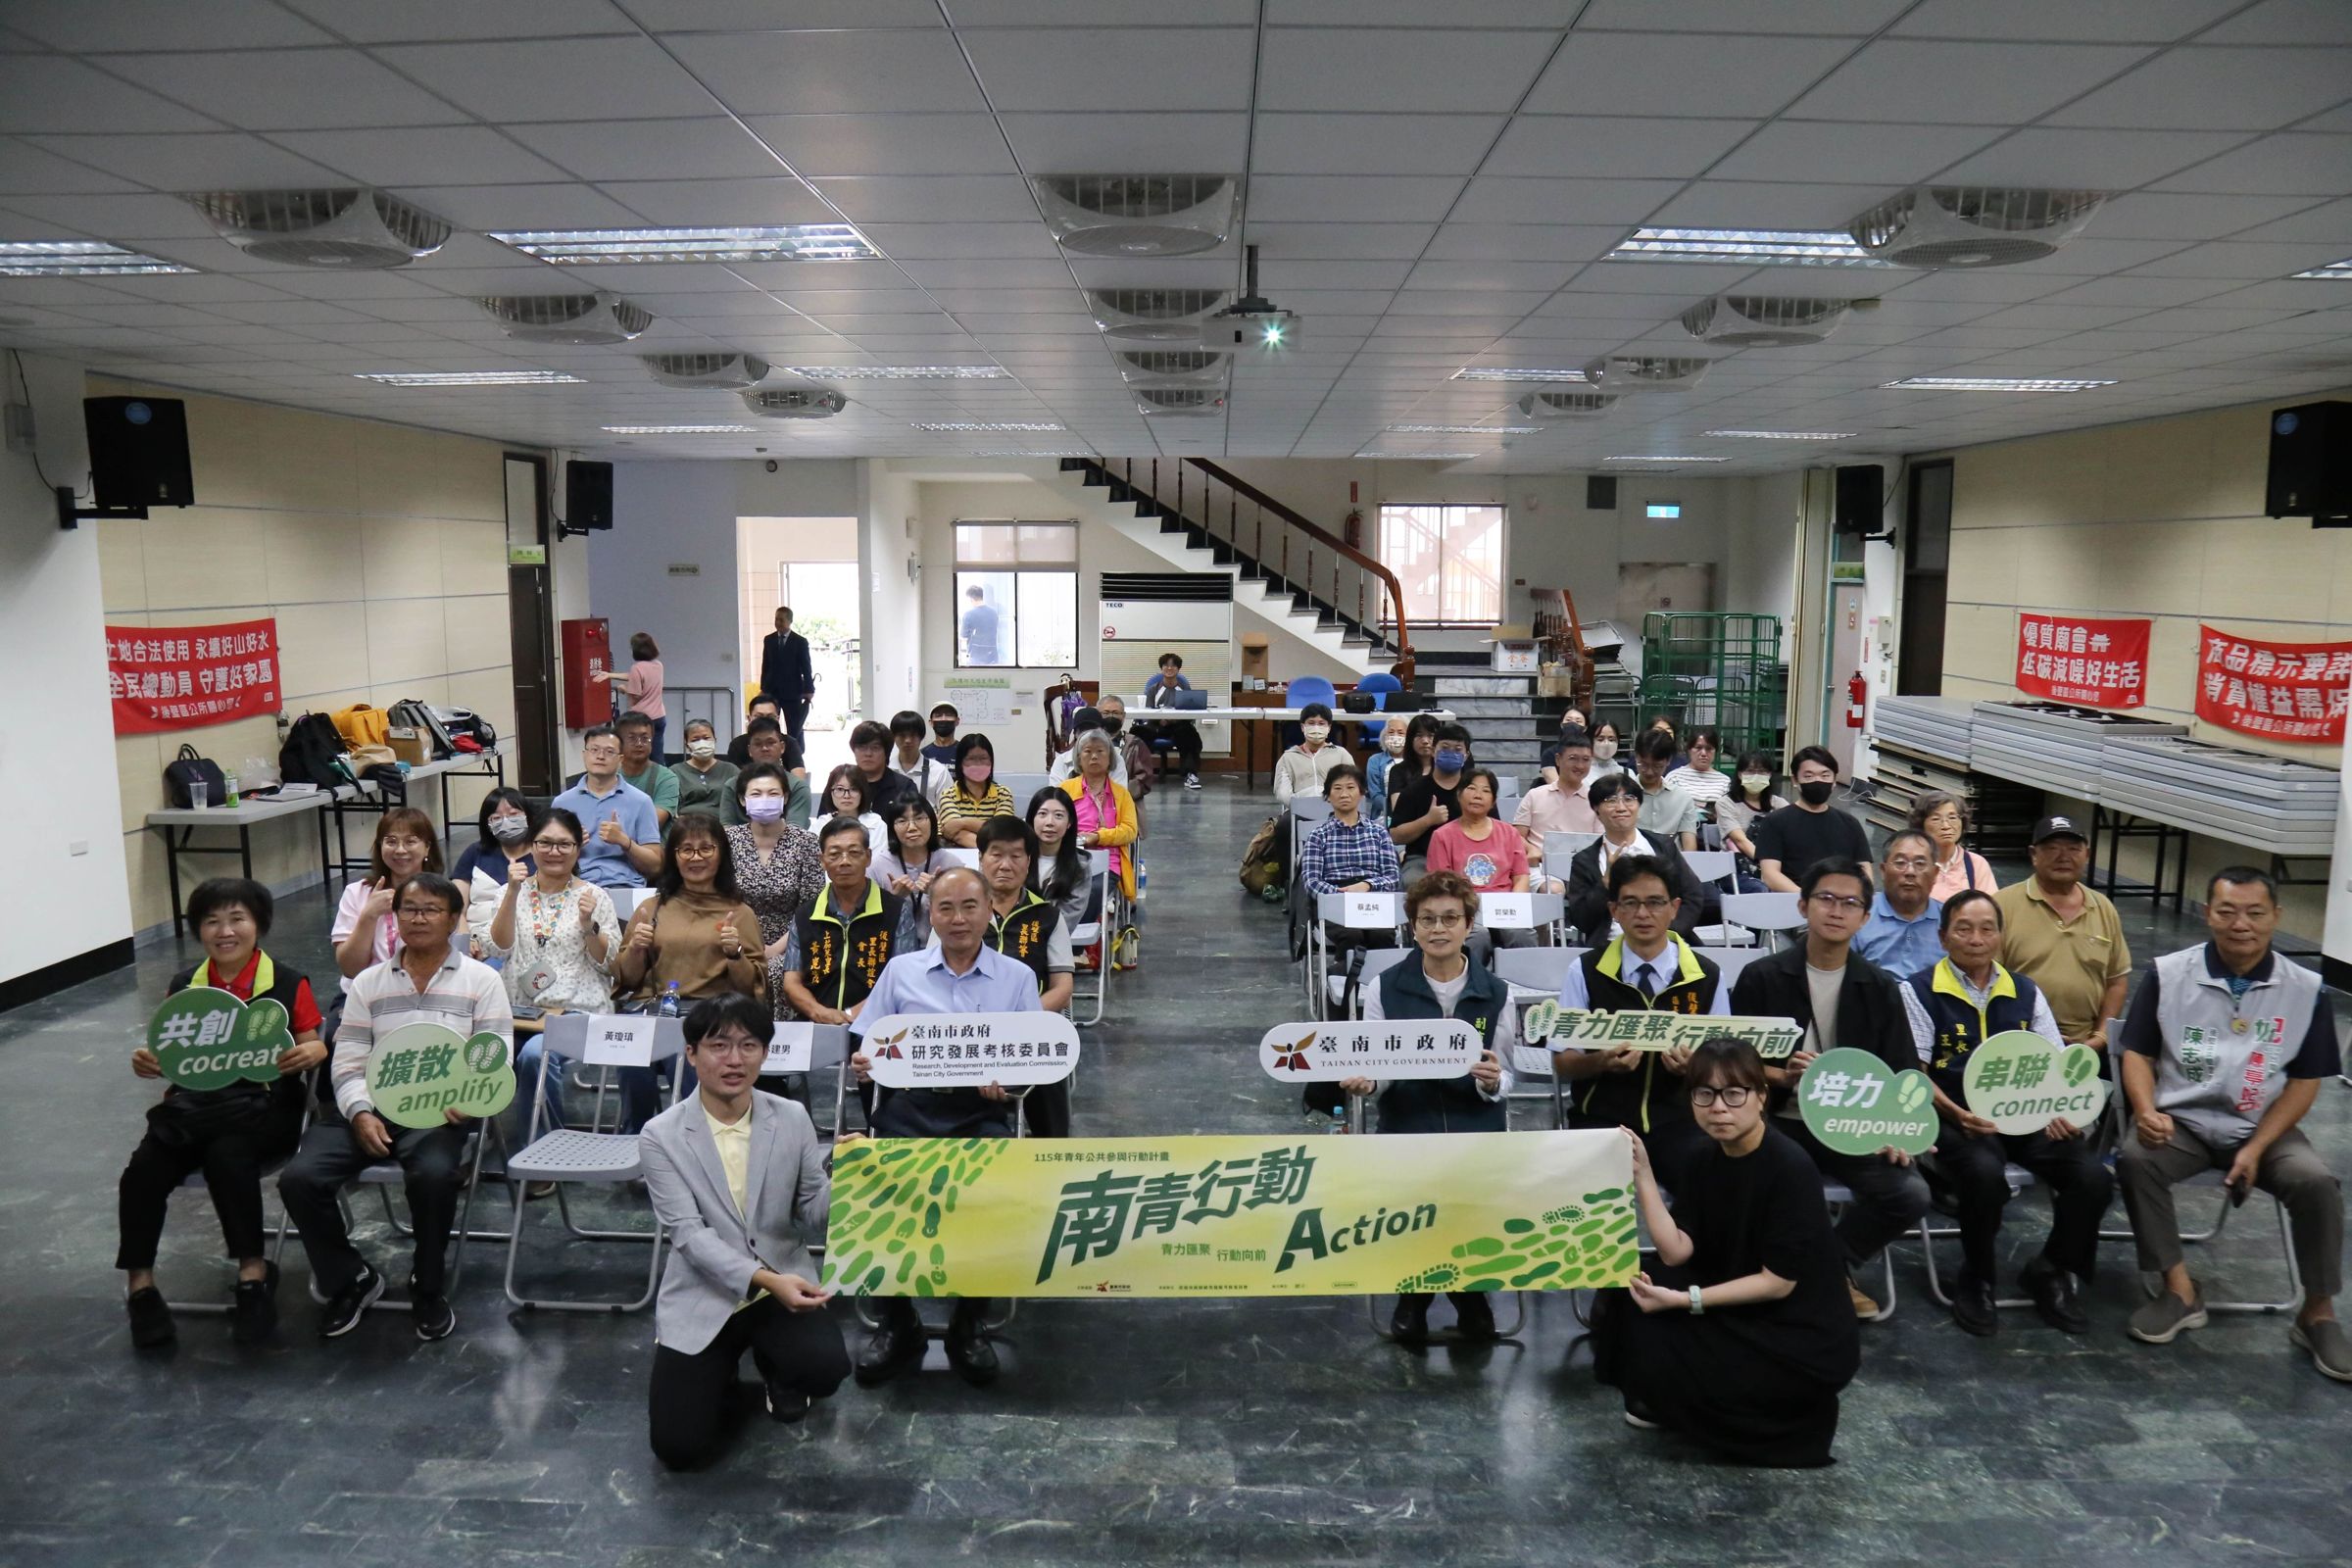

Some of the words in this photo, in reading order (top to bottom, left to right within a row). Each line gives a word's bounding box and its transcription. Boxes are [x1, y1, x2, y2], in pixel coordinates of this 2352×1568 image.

[196, 630, 270, 660] 永續好山好水
[2023, 621, 2088, 654] 優質廟會
[109, 670, 193, 699] 全民總動員
[199, 659, 273, 694] 守護好家園
[2021, 650, 2141, 689] 低碳減噪好生活
[156, 1007, 239, 1051] 共創
[911, 1024, 992, 1039] 臺南市政府
[1551, 1012, 1676, 1041] 青力匯聚
[177, 1044, 283, 1075] cocreat
[768, 1044, 791, 1055] 建男
[911, 1042, 1069, 1059] 研究發展考核委員會
[1319, 1034, 1468, 1054] 臺南市政府
[375, 1043, 458, 1090] 擴散
[1975, 1053, 2052, 1092] 串聯
[397, 1077, 503, 1113] amplify
[1807, 1071, 1886, 1108] 培力
[1991, 1091, 2094, 1117] connect
[1824, 1117, 1929, 1138] empower
[1034, 1152, 1170, 1163] 115年青年公共參與行動計畫
[1035, 1145, 1319, 1286] 南青行動
[1161, 1243, 1211, 1256] 青力匯聚
[1216, 1250, 1266, 1262] 行動向前
[1274, 1203, 1438, 1274] Action
